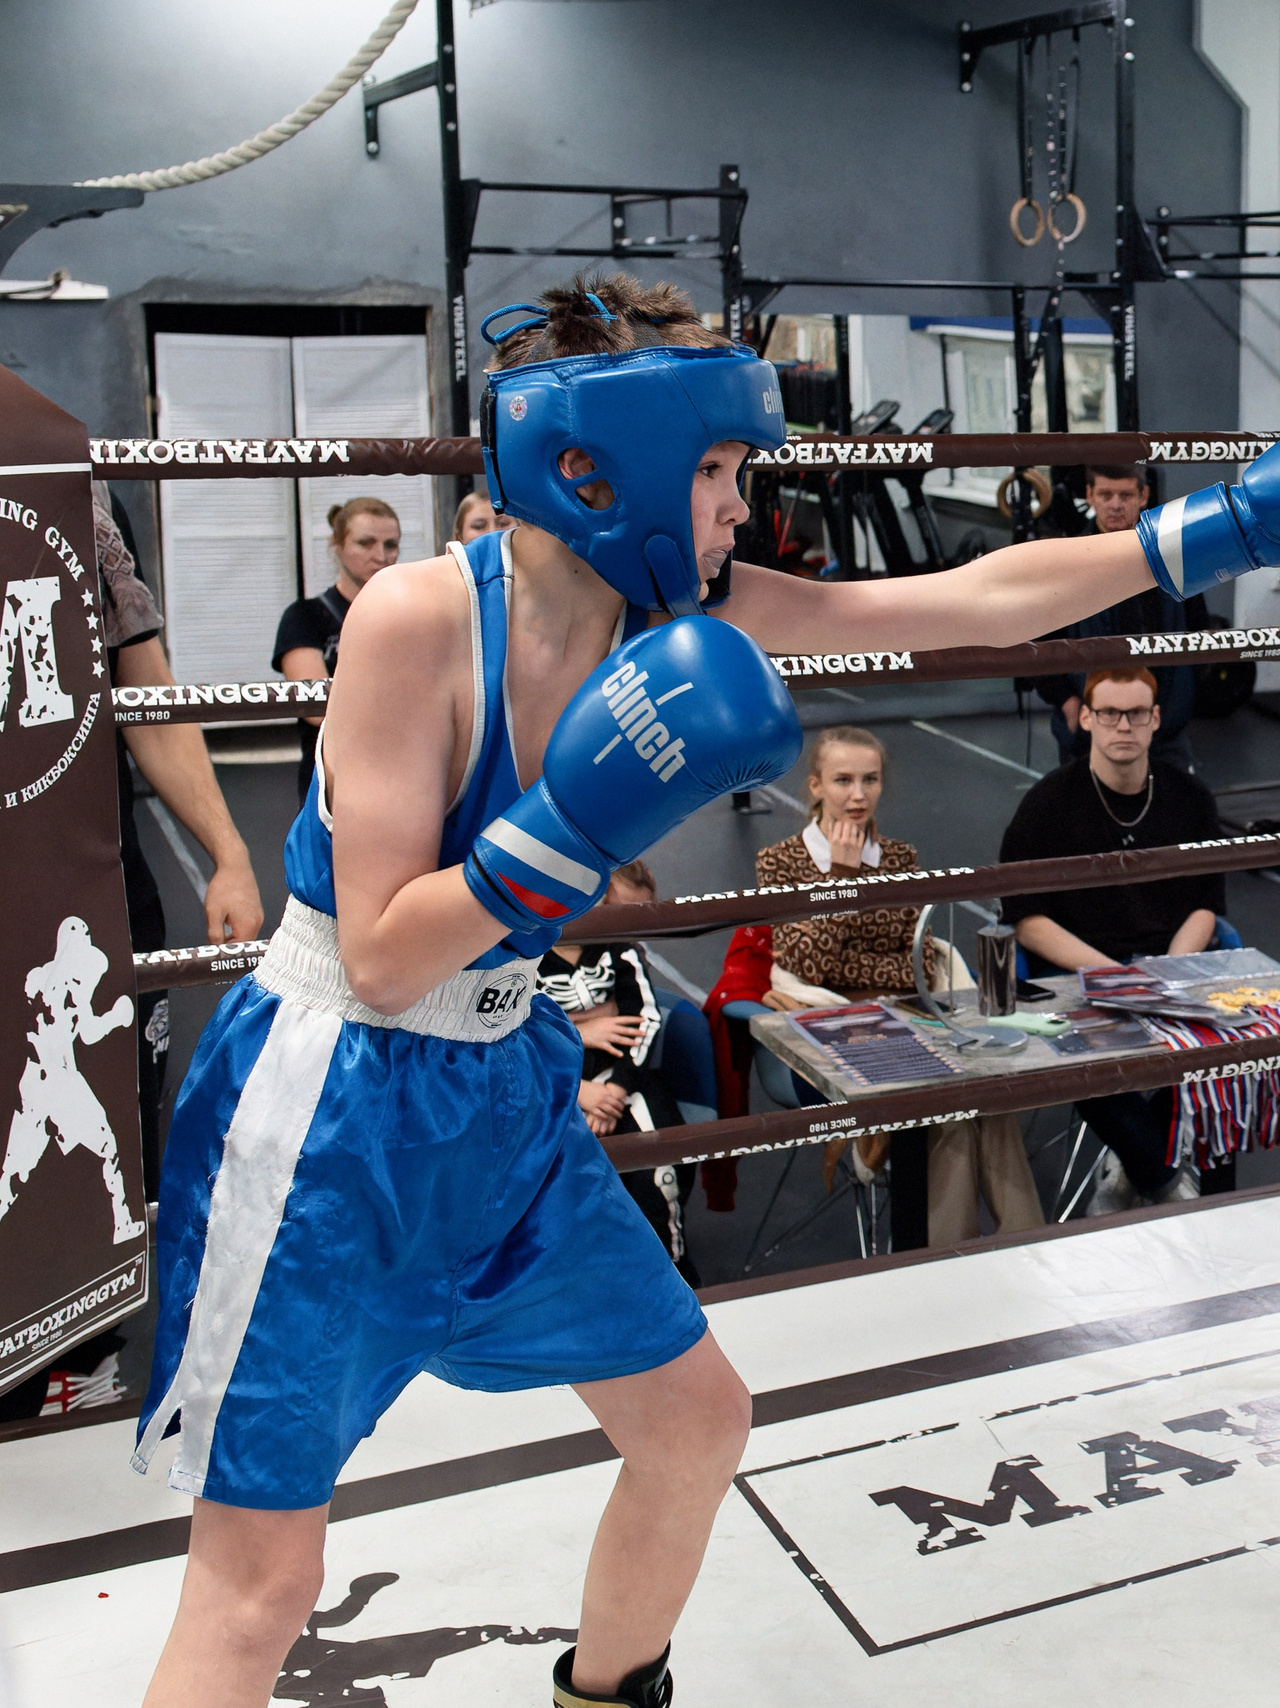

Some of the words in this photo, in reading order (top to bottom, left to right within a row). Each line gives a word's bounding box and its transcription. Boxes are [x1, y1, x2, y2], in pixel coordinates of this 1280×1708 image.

[45, 526, 85, 582] GYM
[1240, 650, 1263, 659] SINCE
[1264, 648, 1280, 658] 1980
[114, 711, 142, 722] INCE
[145, 711, 170, 720] 1980
[601, 661, 686, 784] clinch
[22, 691, 101, 804] КИКБОКСИНГА
[810, 890, 837, 902] SINCE
[838, 888, 858, 899] 1980
[211, 958, 245, 971] SINCE
[476, 986, 527, 1014] BAX
[809, 1120, 828, 1133] 1980
[830, 1116, 857, 1131] SINCE
[0, 1267, 137, 1359] ATBOXINGGYM
